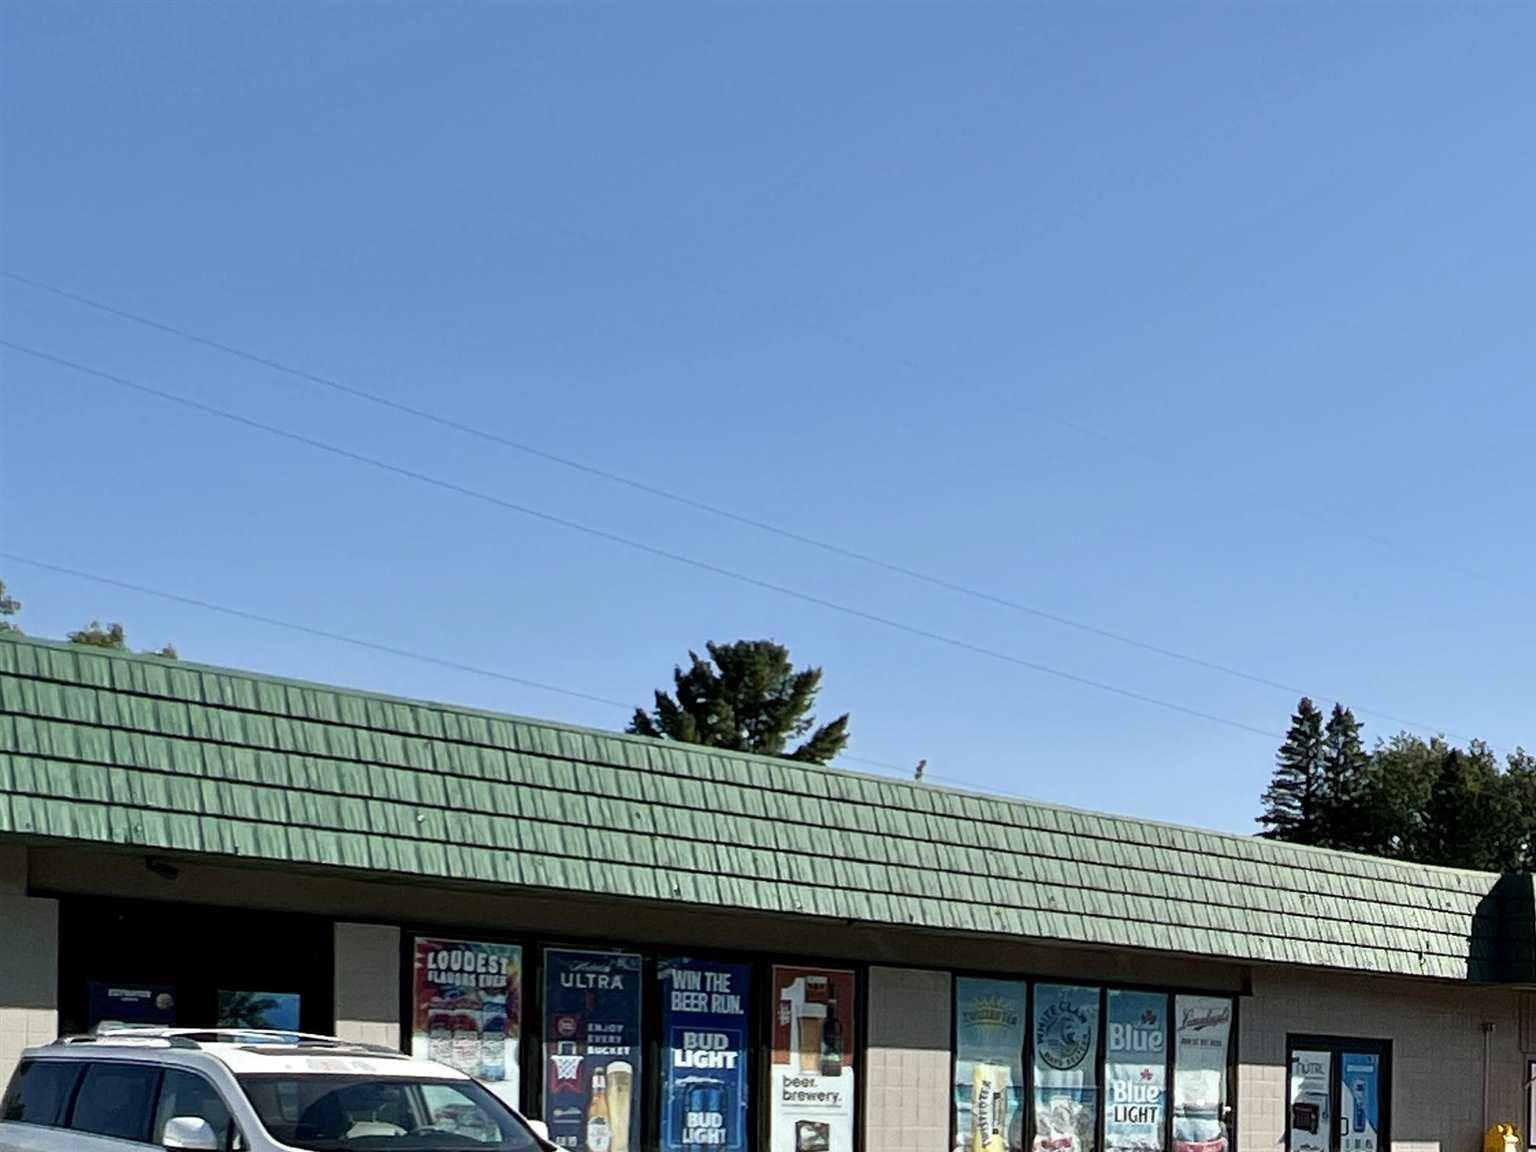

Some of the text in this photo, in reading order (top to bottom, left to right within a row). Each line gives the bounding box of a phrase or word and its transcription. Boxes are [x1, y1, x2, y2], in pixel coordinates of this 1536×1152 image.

[427, 950, 509, 974] LOUDEST
[427, 970, 476, 987] FLAVORS
[560, 972, 625, 990] ULTRA
[671, 969, 733, 994] WIN THE
[671, 991, 745, 1015] BEER RUN.
[586, 1023, 625, 1034] ENJOY
[1110, 1022, 1163, 1052] Blue
[683, 1031, 730, 1051] BUD
[673, 1050, 739, 1069] LIGHT
[1113, 1079, 1160, 1104] Blue
[686, 1111, 724, 1129] BUD
[1113, 1105, 1159, 1124] LIGHT
[682, 1128, 727, 1145] LIGHT
